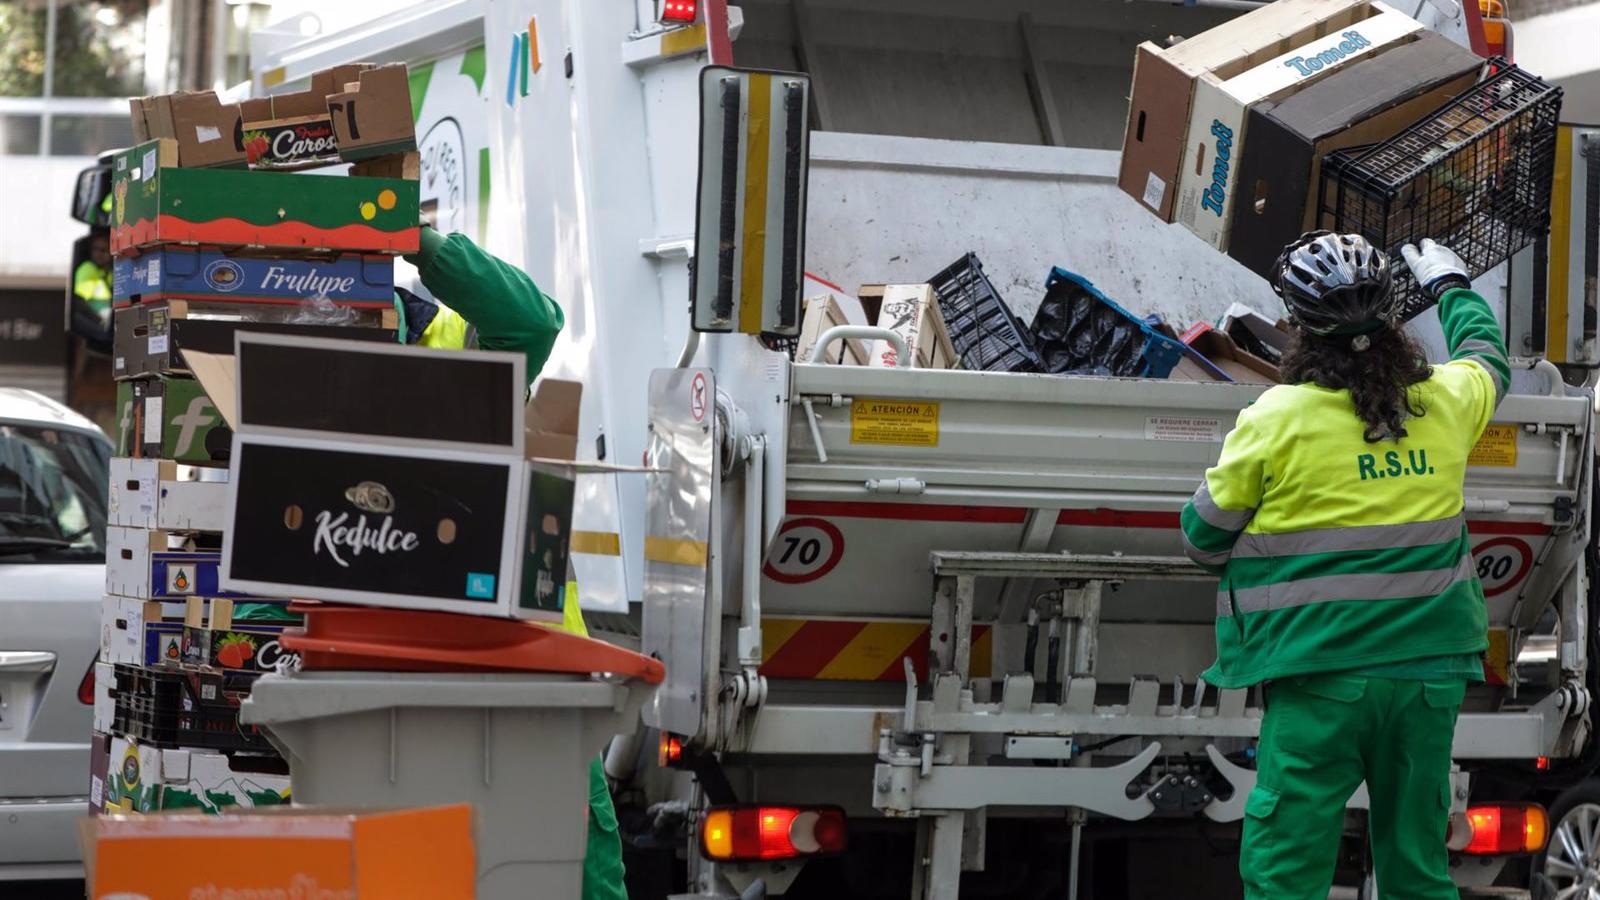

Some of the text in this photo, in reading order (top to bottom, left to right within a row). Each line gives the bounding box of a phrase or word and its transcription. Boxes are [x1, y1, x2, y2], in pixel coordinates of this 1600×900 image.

[260, 266, 355, 297] Frulupe
[871, 404, 919, 414] ATENCIÓN
[1357, 448, 1435, 481] R.S.U.
[313, 510, 420, 568] Kedulce
[779, 537, 821, 566] 70
[1478, 554, 1513, 580] 80
